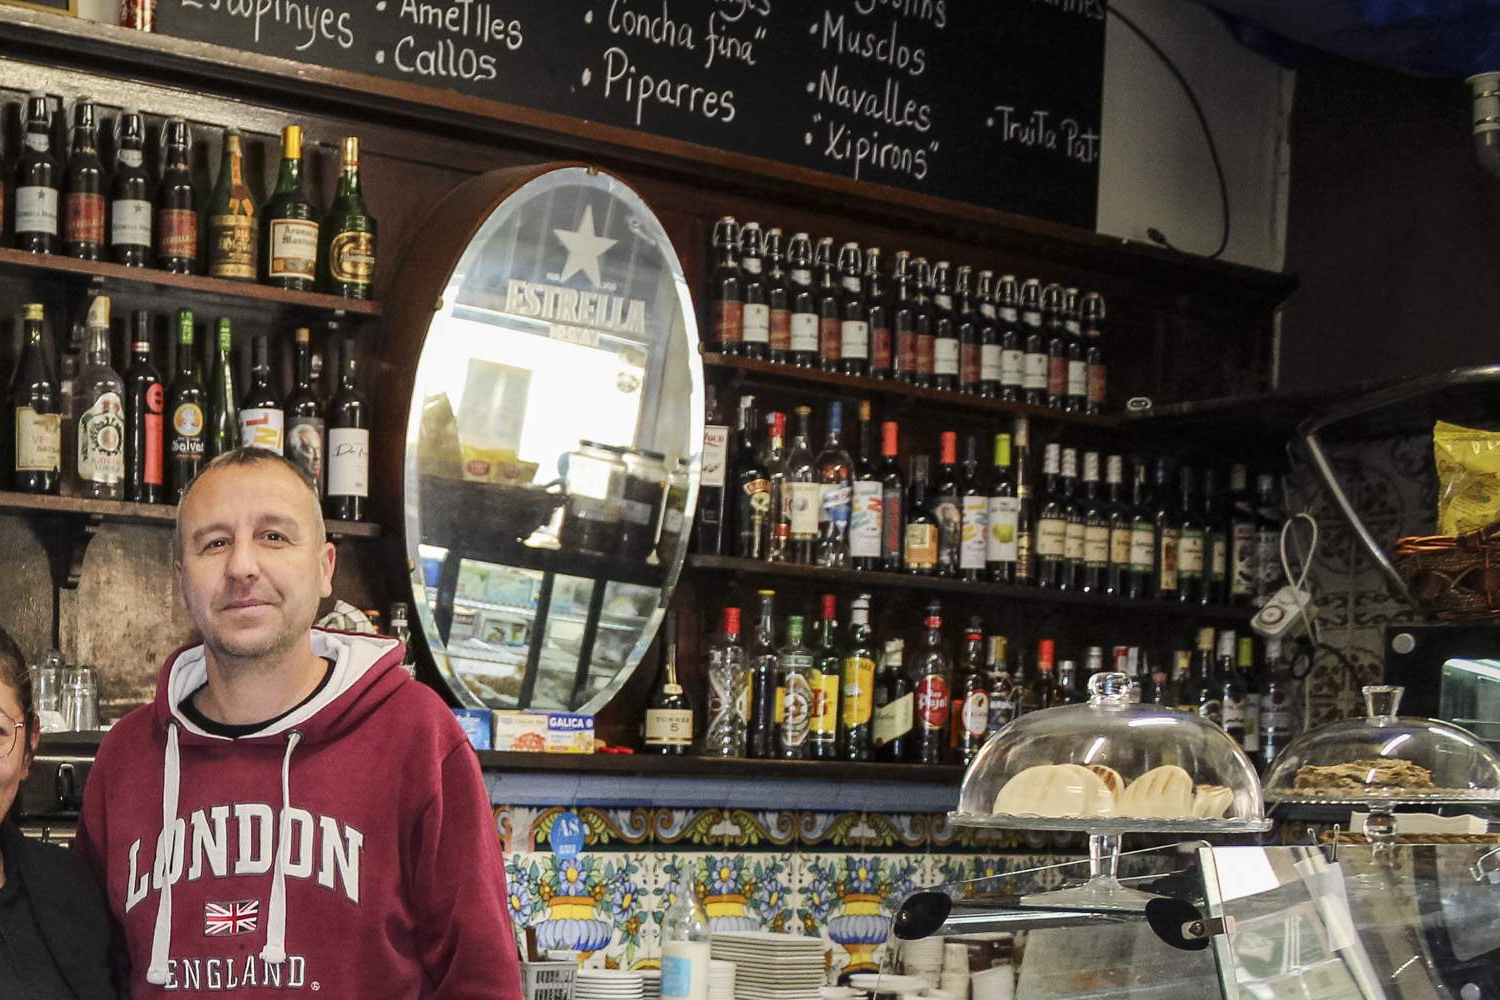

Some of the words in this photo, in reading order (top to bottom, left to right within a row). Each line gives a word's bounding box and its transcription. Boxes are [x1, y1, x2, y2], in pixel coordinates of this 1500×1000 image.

[607, 0, 696, 50] Concha
[821, 12, 926, 76] Musclos
[394, 35, 498, 81] Callos
[603, 48, 737, 126] Piparres
[817, 69, 932, 132] Navalles
[505, 278, 647, 333] ESTRELLA
[670, 723, 680, 733] 5
[125, 803, 364, 914] LONDON
[164, 955, 306, 990] ENGLAND
